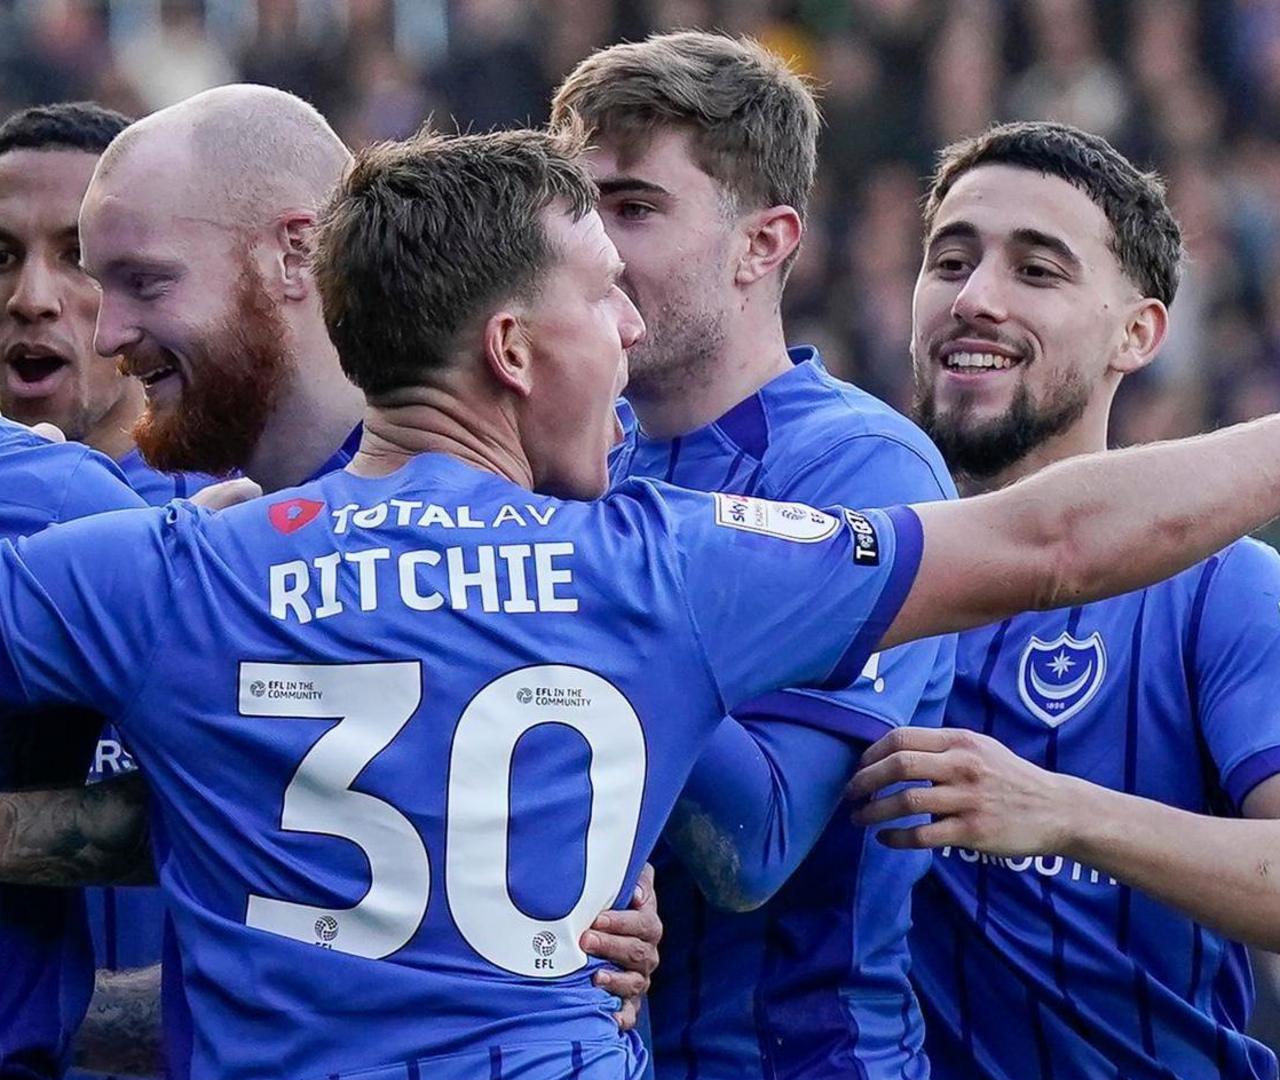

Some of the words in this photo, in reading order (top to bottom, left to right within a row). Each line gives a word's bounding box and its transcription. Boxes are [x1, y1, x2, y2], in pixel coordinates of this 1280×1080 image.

[269, 541, 579, 624] RITCHIE
[268, 680, 284, 690] EFL
[286, 681, 297, 690] IN
[299, 681, 314, 691] THE
[268, 690, 323, 700] COMMUNITY
[535, 687, 553, 697] EFL
[554, 688, 565, 697] IN
[567, 688, 582, 698] THE
[535, 697, 592, 707] COMMUNITY
[237, 659, 648, 979] 30
[534, 958, 555, 969] EFL
